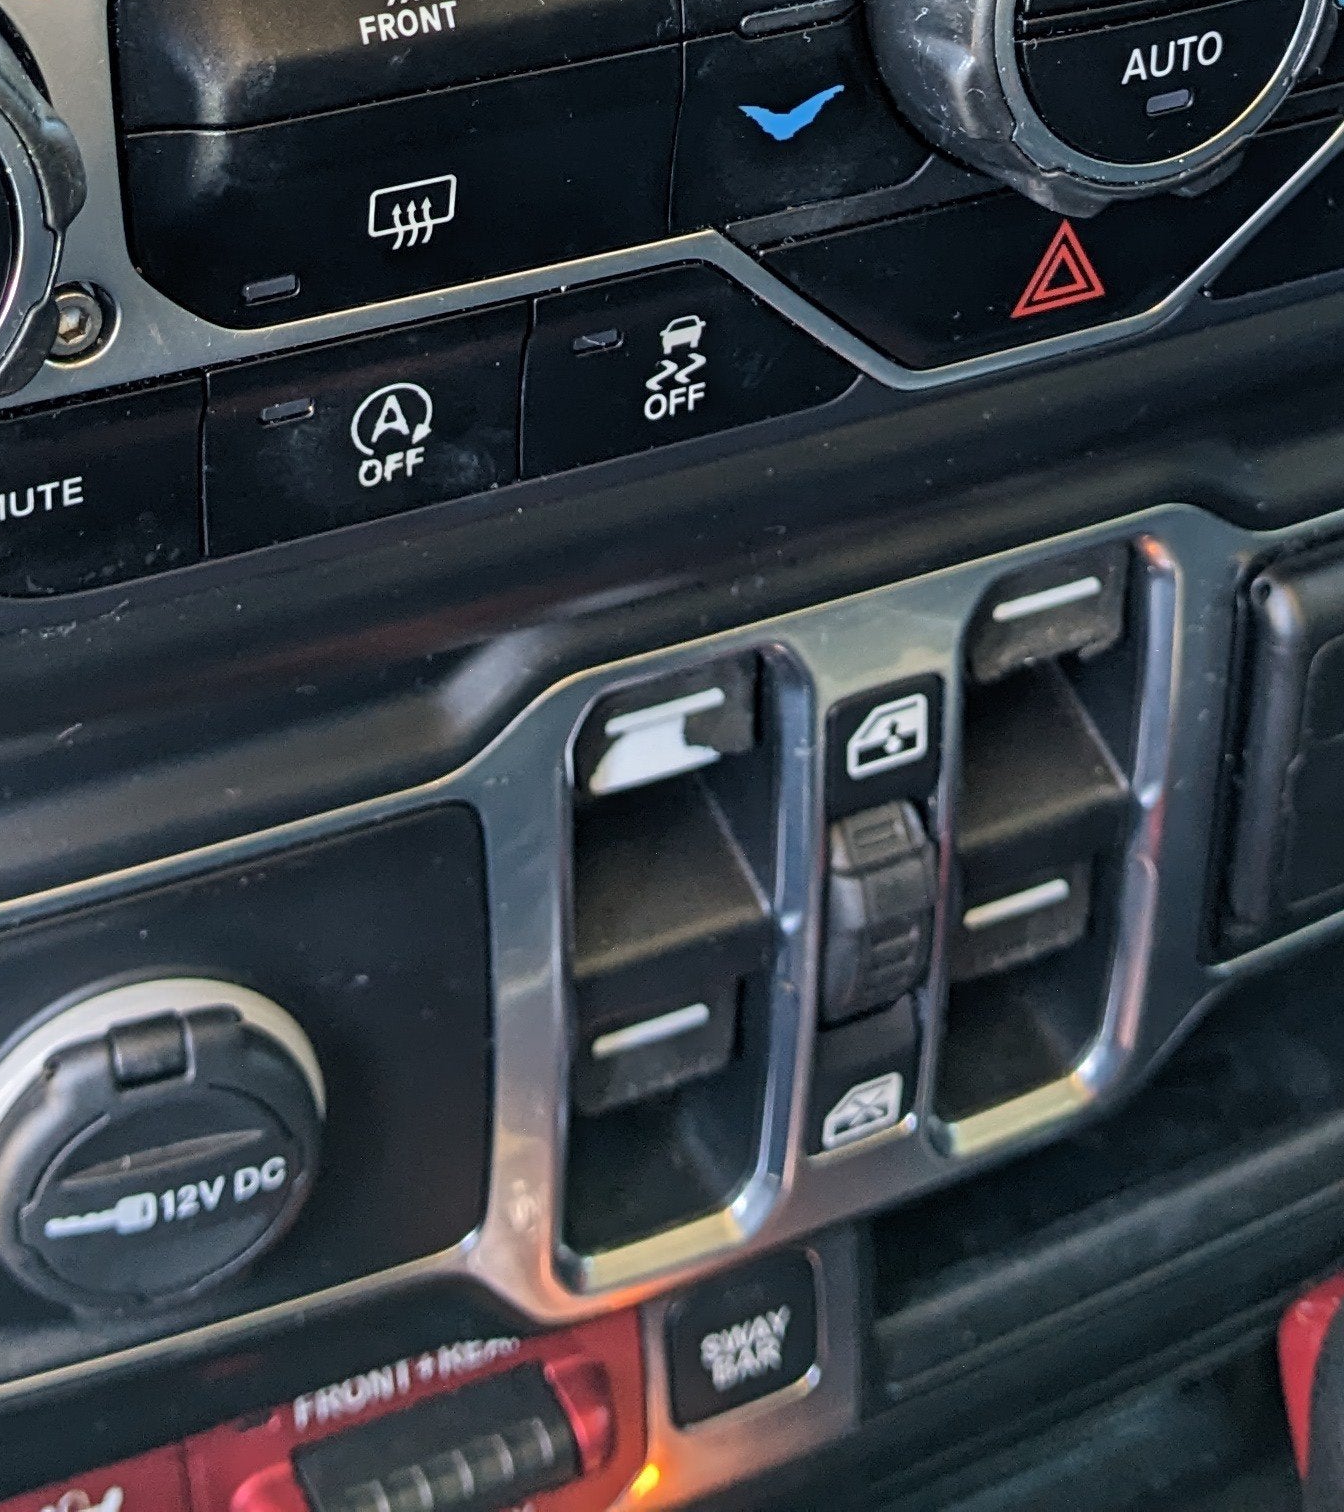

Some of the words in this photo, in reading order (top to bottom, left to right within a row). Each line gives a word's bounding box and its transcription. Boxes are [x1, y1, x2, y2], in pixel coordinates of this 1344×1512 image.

[359, 0, 457, 44] FRONT
[1122, 31, 1223, 84] AUTO
[644, 382, 706, 420] OFF
[358, 446, 425, 487] OFF
[159, 1175, 226, 1223] 12V
[233, 1156, 287, 1203] DC
[701, 1305, 791, 1368] SWAY
